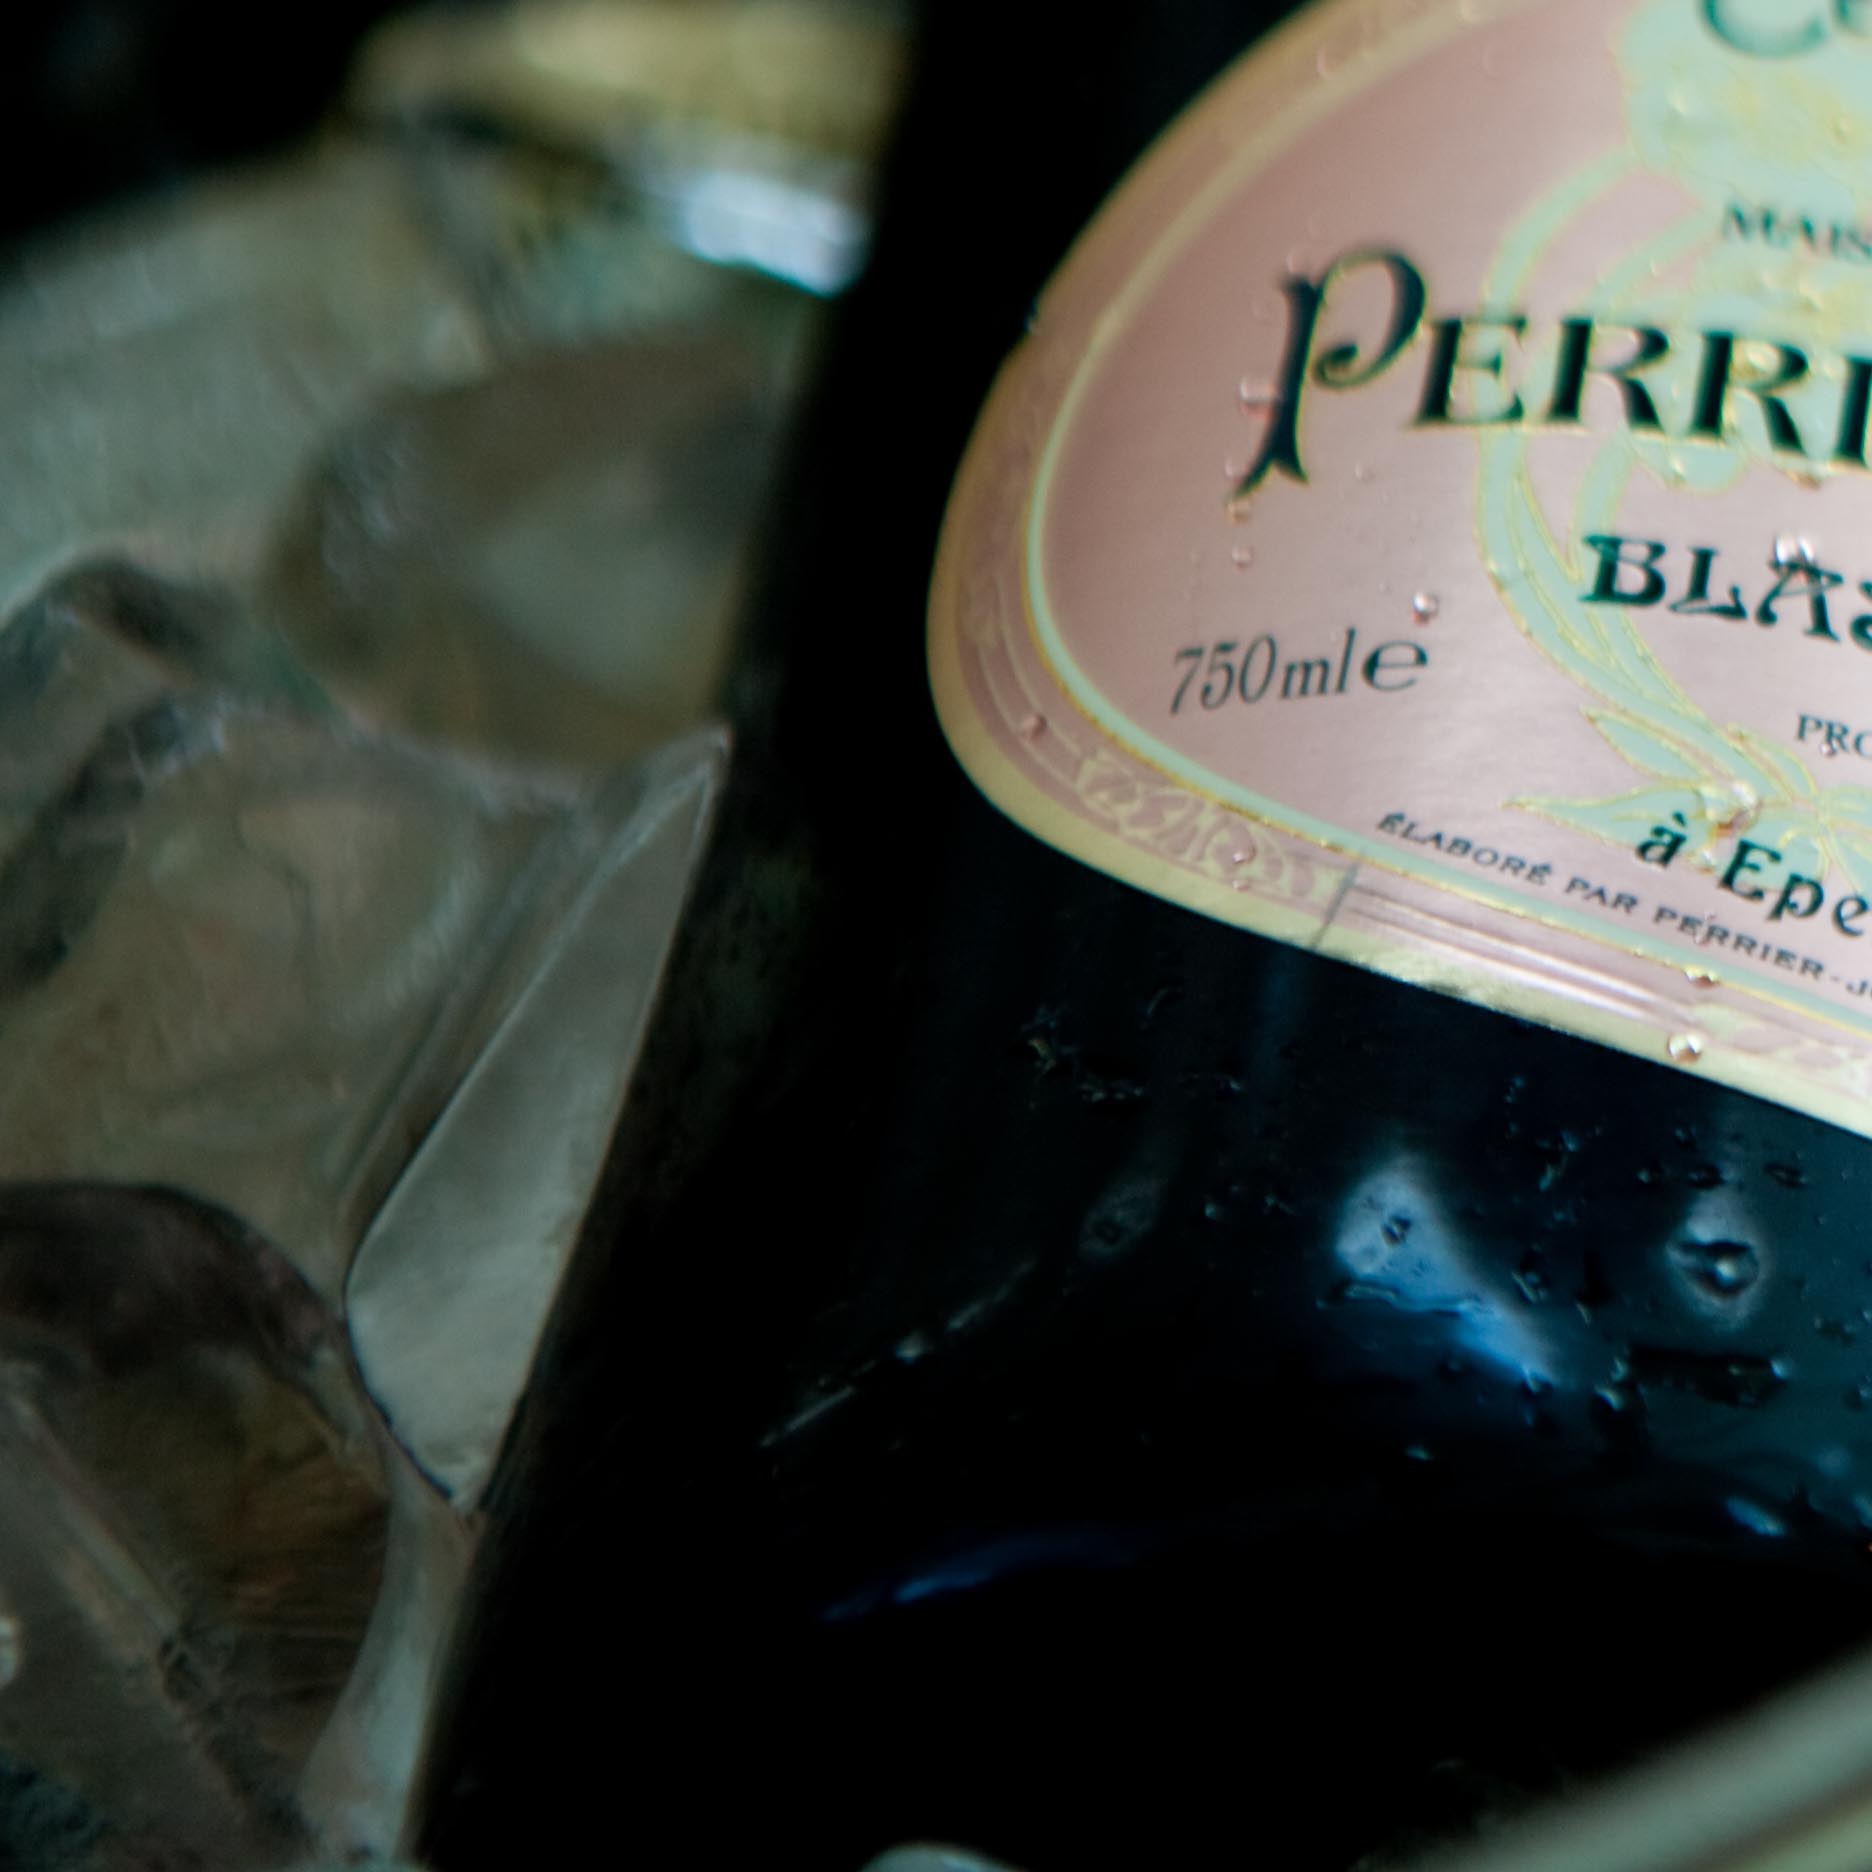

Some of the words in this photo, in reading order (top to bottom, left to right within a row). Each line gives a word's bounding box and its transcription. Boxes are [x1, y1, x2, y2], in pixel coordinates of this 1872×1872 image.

[1375, 810, 1555, 886] ÉLABORÉ
[1563, 874, 1640, 916] PAR
[1634, 810, 1688, 870] à
